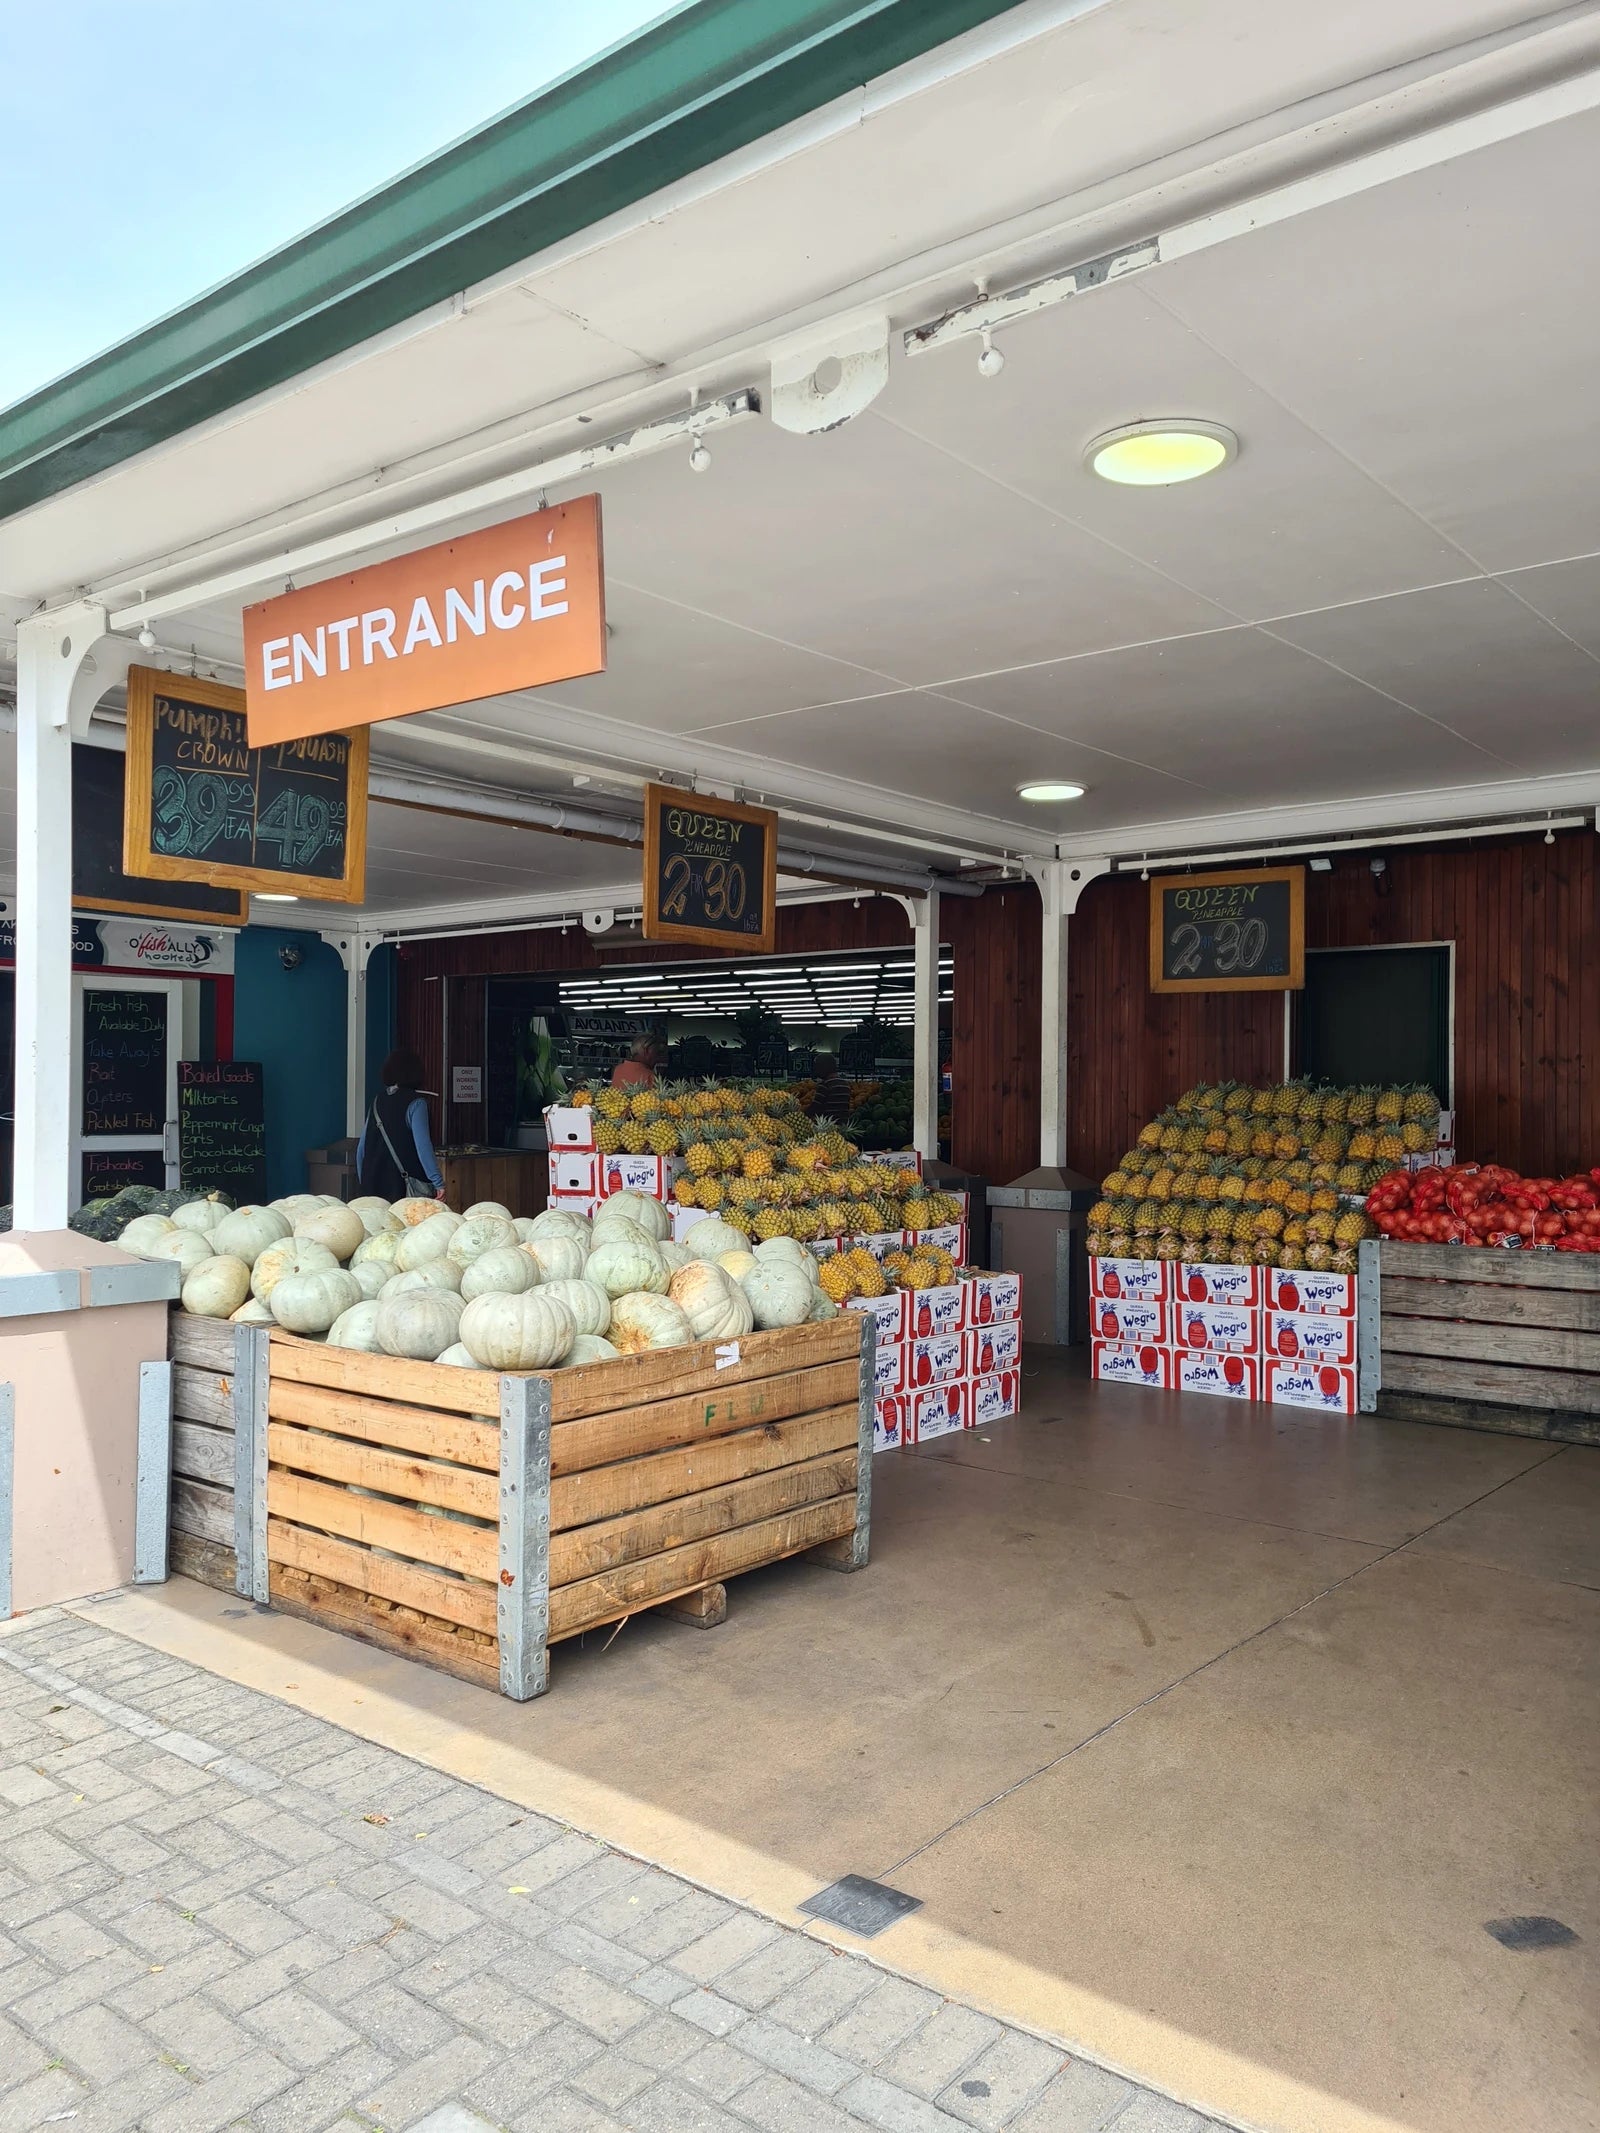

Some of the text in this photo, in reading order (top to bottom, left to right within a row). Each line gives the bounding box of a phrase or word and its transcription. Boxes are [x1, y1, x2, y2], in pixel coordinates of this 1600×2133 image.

[262, 554, 569, 691] ENTRANCE
[177, 741, 250, 771] CROWN
[667, 808, 743, 843] QUEEN
[684, 838, 732, 857] PINEAPPLE
[662, 853, 691, 917] 2
[704, 860, 746, 921] 30
[1175, 886, 1260, 910] QUEEN
[1192, 906, 1246, 920] PINEAPPLE
[1171, 922, 1202, 976] 2
[1213, 917, 1269, 974] 30
[144, 951, 195, 962] hooked
[88, 992, 148, 1012] Fresh Fish
[99, 1015, 165, 1041] Available Daily
[575, 1017, 638, 1032] AVOLANDS
[87, 1039, 114, 1058] Take
[180, 1062, 255, 1084] Baked Goods
[87, 1089, 133, 1111] Oysters
[87, 1111, 157, 1130] Pickled Fish
[181, 1133, 215, 1144] tarts
[181, 1144, 243, 1159] Chocolate
[87, 1154, 144, 1172] Fishcakes
[181, 1161, 255, 1176] Carrot Cakes
[626, 1168, 655, 1186] Wegro
[1125, 1271, 1158, 1287] Wegro
[1212, 1275, 1247, 1291] Wegro
[995, 1286, 1017, 1307] Wegro
[1304, 1284, 1344, 1300] Wegro
[935, 1297, 960, 1320] Wegro
[1123, 1312, 1156, 1327] Wegro
[1211, 1322, 1247, 1337] Wegro
[1303, 1331, 1343, 1346] Wegro
[996, 1333, 1017, 1355] Wegro
[935, 1345, 959, 1368] Wegro
[1102, 1357, 1136, 1371] Wegro
[1184, 1367, 1219, 1382] Wegro
[1276, 1377, 1315, 1391] Wegro
[978, 1390, 999, 1413] Wegro
[920, 1403, 945, 1428] Wegro
